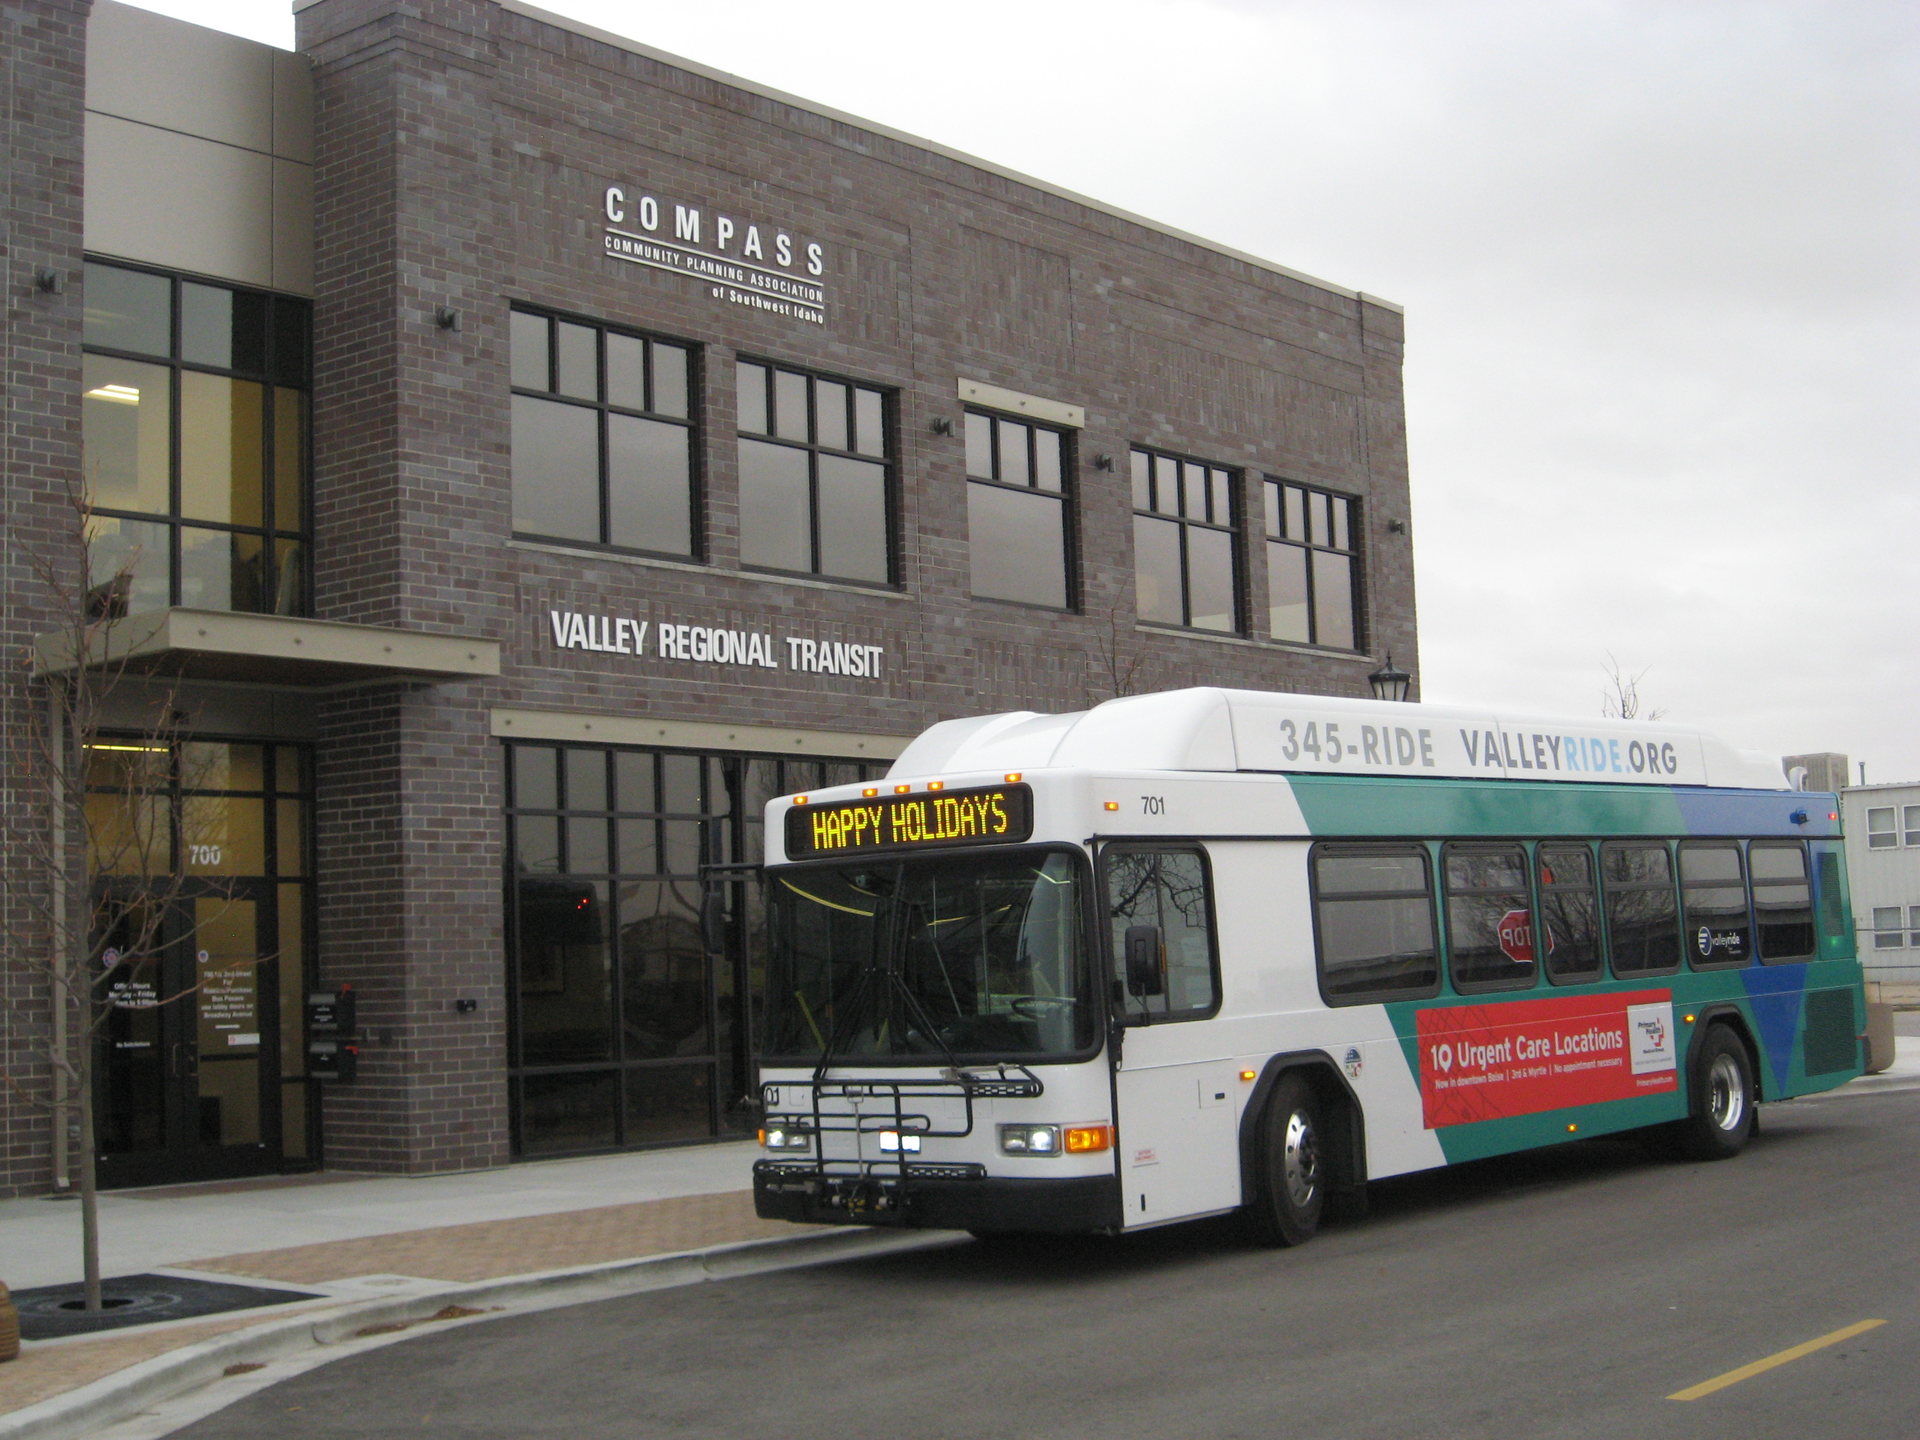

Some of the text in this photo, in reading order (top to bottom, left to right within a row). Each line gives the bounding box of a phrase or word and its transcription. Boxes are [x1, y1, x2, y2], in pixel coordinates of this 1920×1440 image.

[606, 187, 823, 276] COMPASS
[604, 235, 823, 302] COMMUNITY PLANNING ASSOCIATION
[712, 286, 824, 325] of Southwest Idaho
[551, 611, 884, 679] VALLEY REGIONAL TRANSIT
[1280, 718, 1678, 775] 345-RIDE VALLEYRIDE.ORG
[812, 793, 1008, 850] HAPPY HOLIDAYS
[1141, 796, 1165, 815] 701
[189, 845, 221, 865] 700
[1431, 1026, 1624, 1073] 10 Urgent Care Locations
[1435, 1079, 1449, 1089] Now
[1457, 1075, 1487, 1086] downtown
[1487, 1072, 1504, 1082] Boise
[1511, 1069, 1522, 1079] 3rd
[1528, 1066, 1547, 1078] Myrtle
[1553, 1064, 1562, 1073] No
[1563, 1060, 1597, 1073] appointment
[1597, 1057, 1623, 1068] necessary
